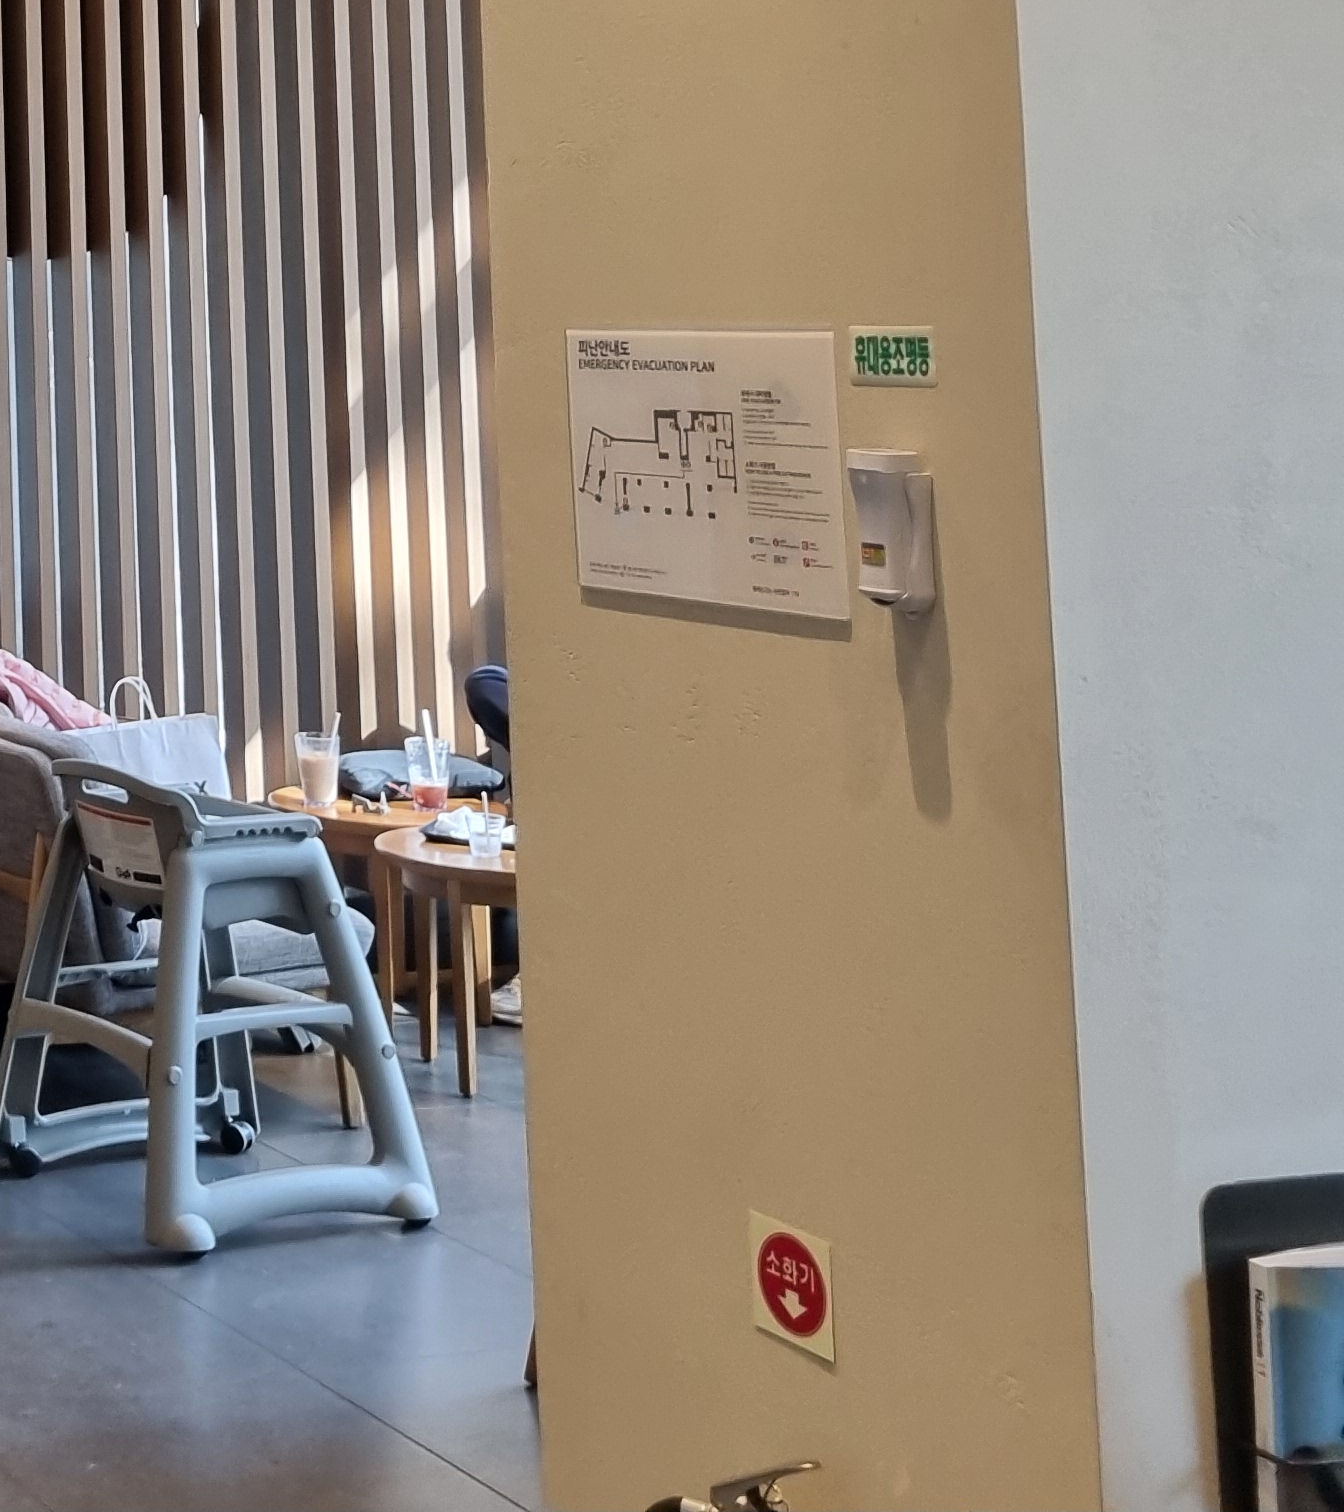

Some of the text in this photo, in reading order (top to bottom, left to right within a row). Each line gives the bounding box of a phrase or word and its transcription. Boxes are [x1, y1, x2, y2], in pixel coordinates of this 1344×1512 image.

[578, 340, 630, 356] 피난안내도
[855, 335, 930, 376] 휴대용조명등
[578, 359, 715, 372] EMERGENCY EVACUATION PLAN
[766, 1250, 815, 1294] 소화기
